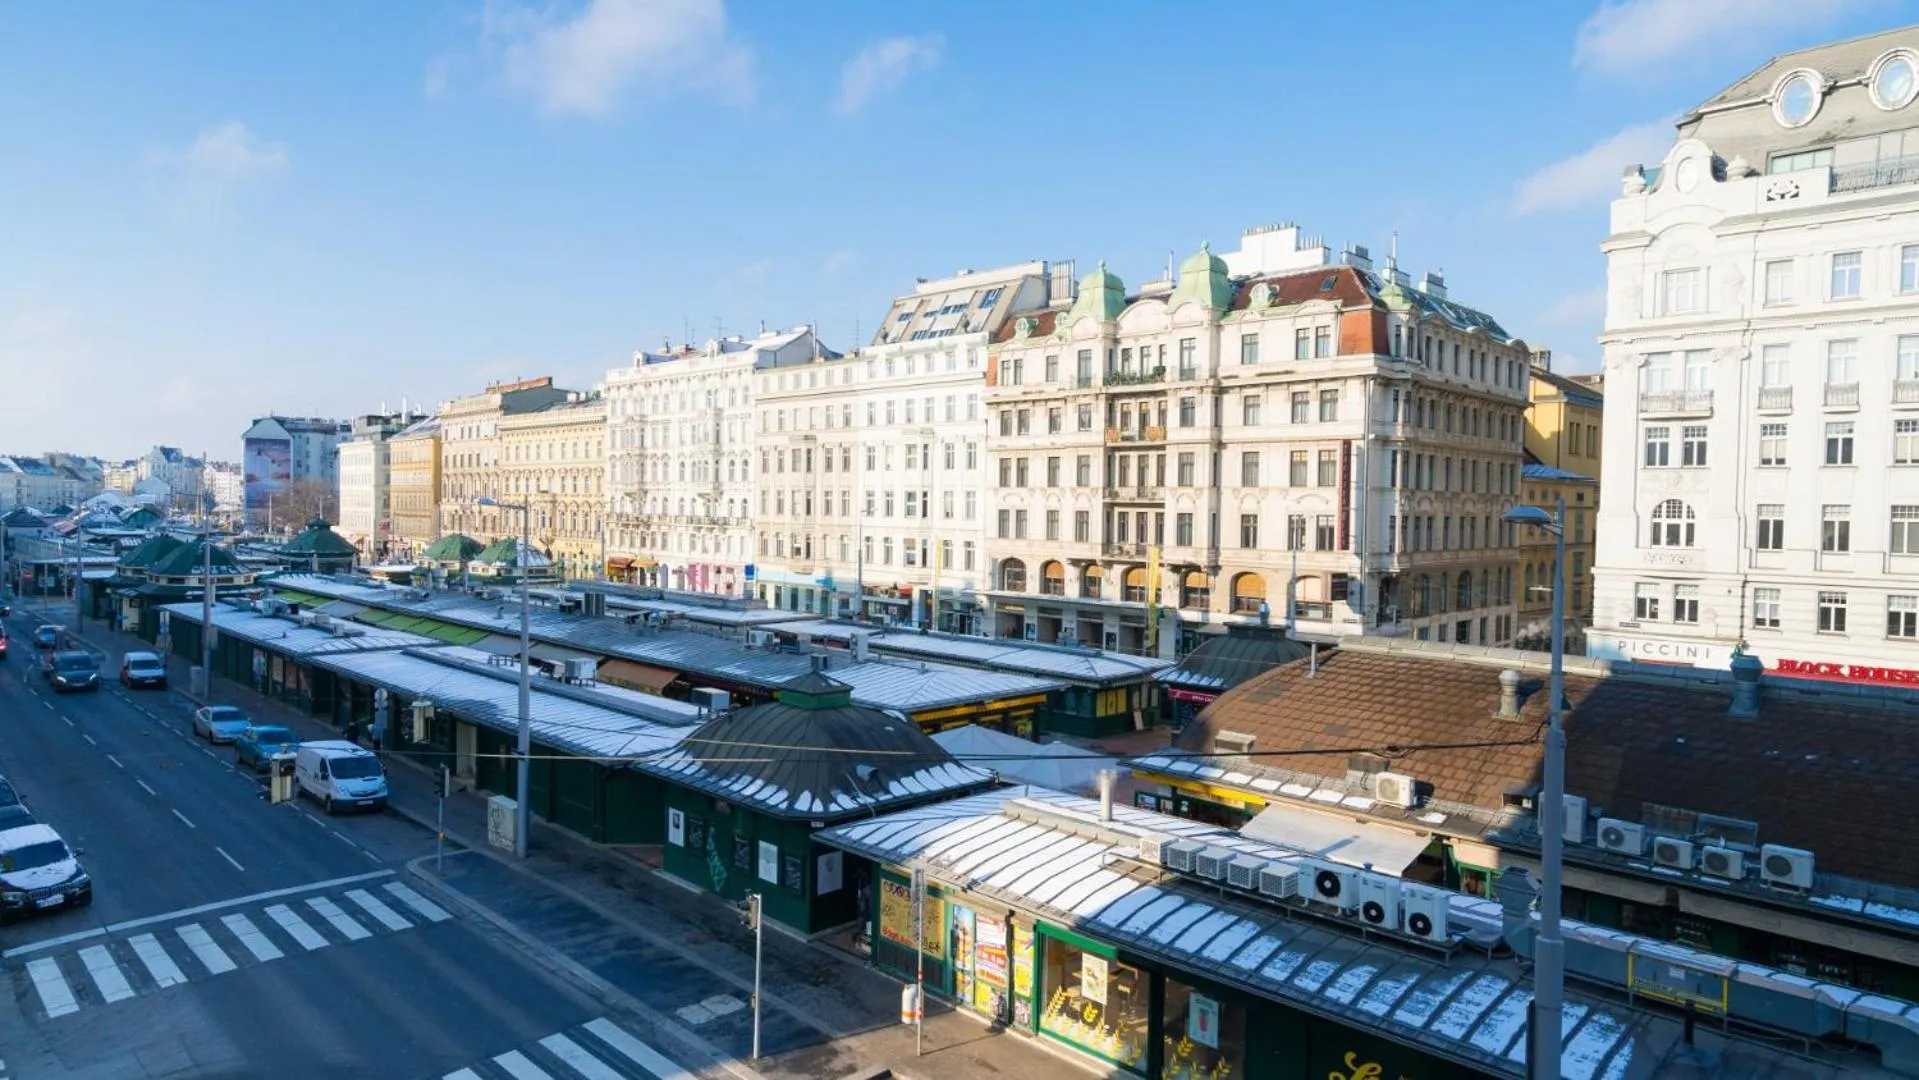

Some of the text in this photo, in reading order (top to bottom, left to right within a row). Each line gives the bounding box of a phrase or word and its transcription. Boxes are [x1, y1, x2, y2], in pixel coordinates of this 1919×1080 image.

[1618, 641, 1710, 660] PICCINI
[1777, 659, 1919, 683] BLOCK HOUSE
